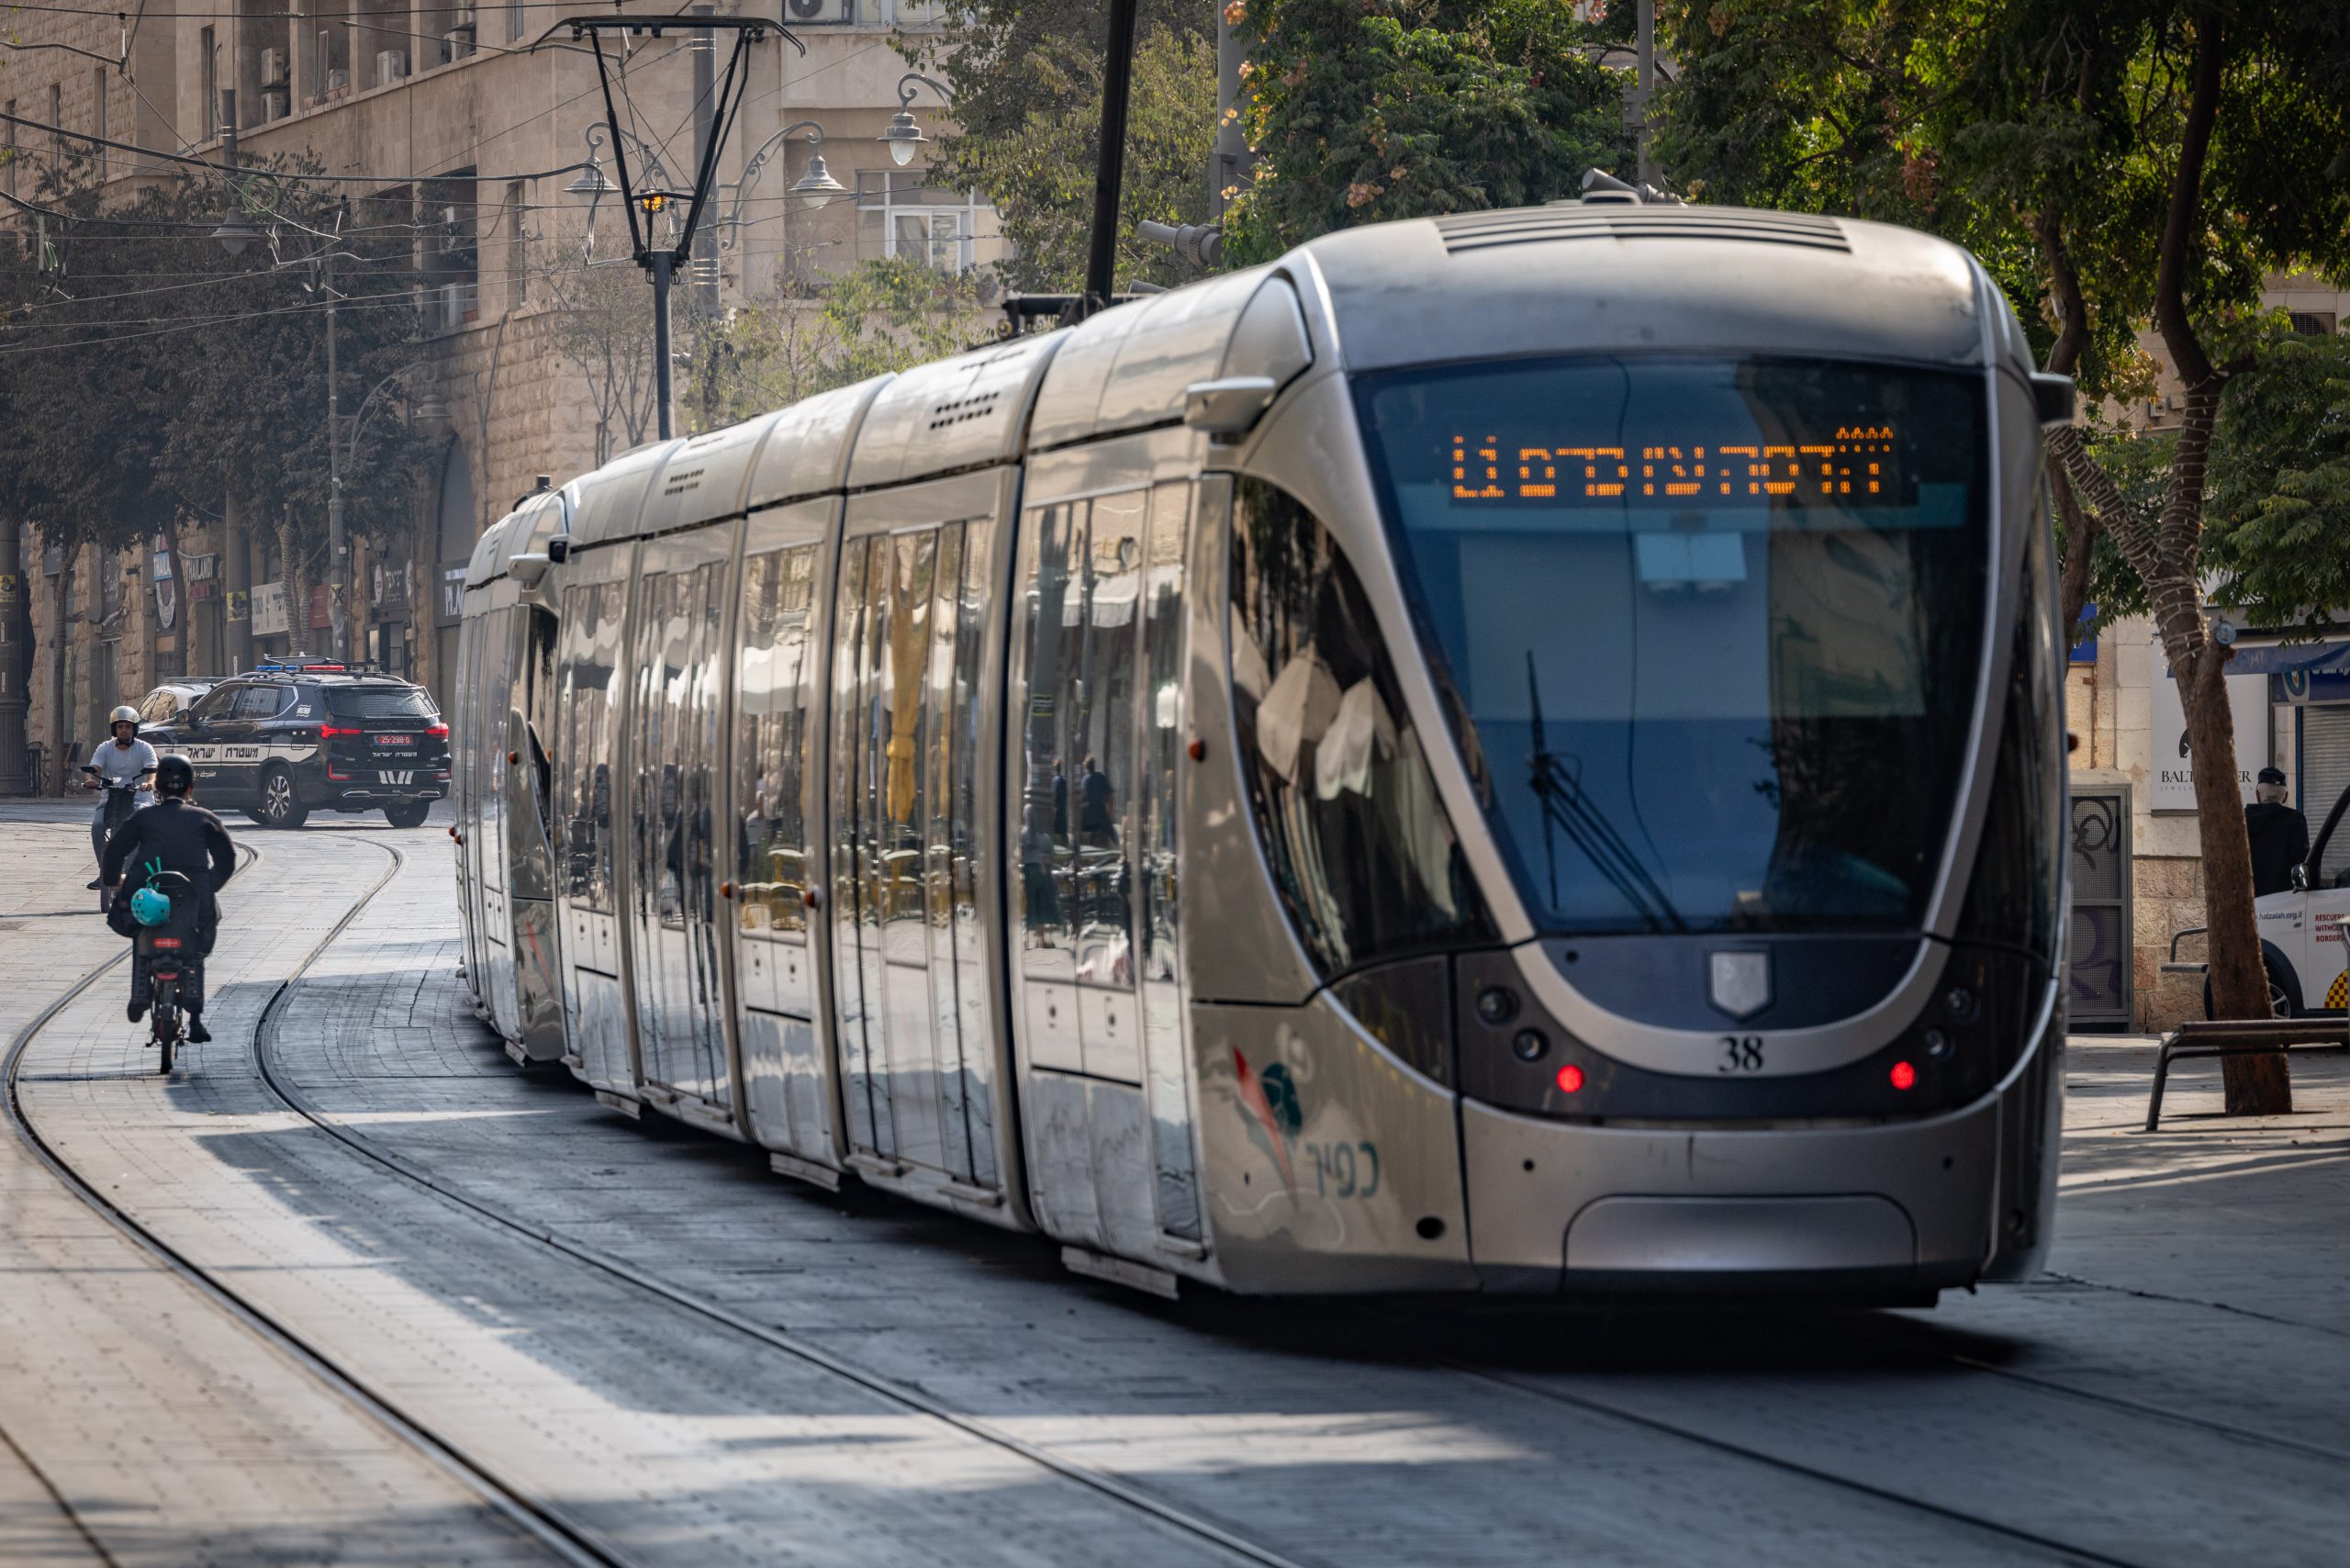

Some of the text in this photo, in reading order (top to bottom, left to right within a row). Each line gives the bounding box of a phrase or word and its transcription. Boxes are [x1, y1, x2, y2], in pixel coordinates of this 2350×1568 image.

[186, 746, 259, 759] משטרת ישראל
[2315, 924, 2343, 932] WITHOU
[1718, 1036, 1762, 1072] 38
[1305, 1140, 1380, 1198] כפיר
